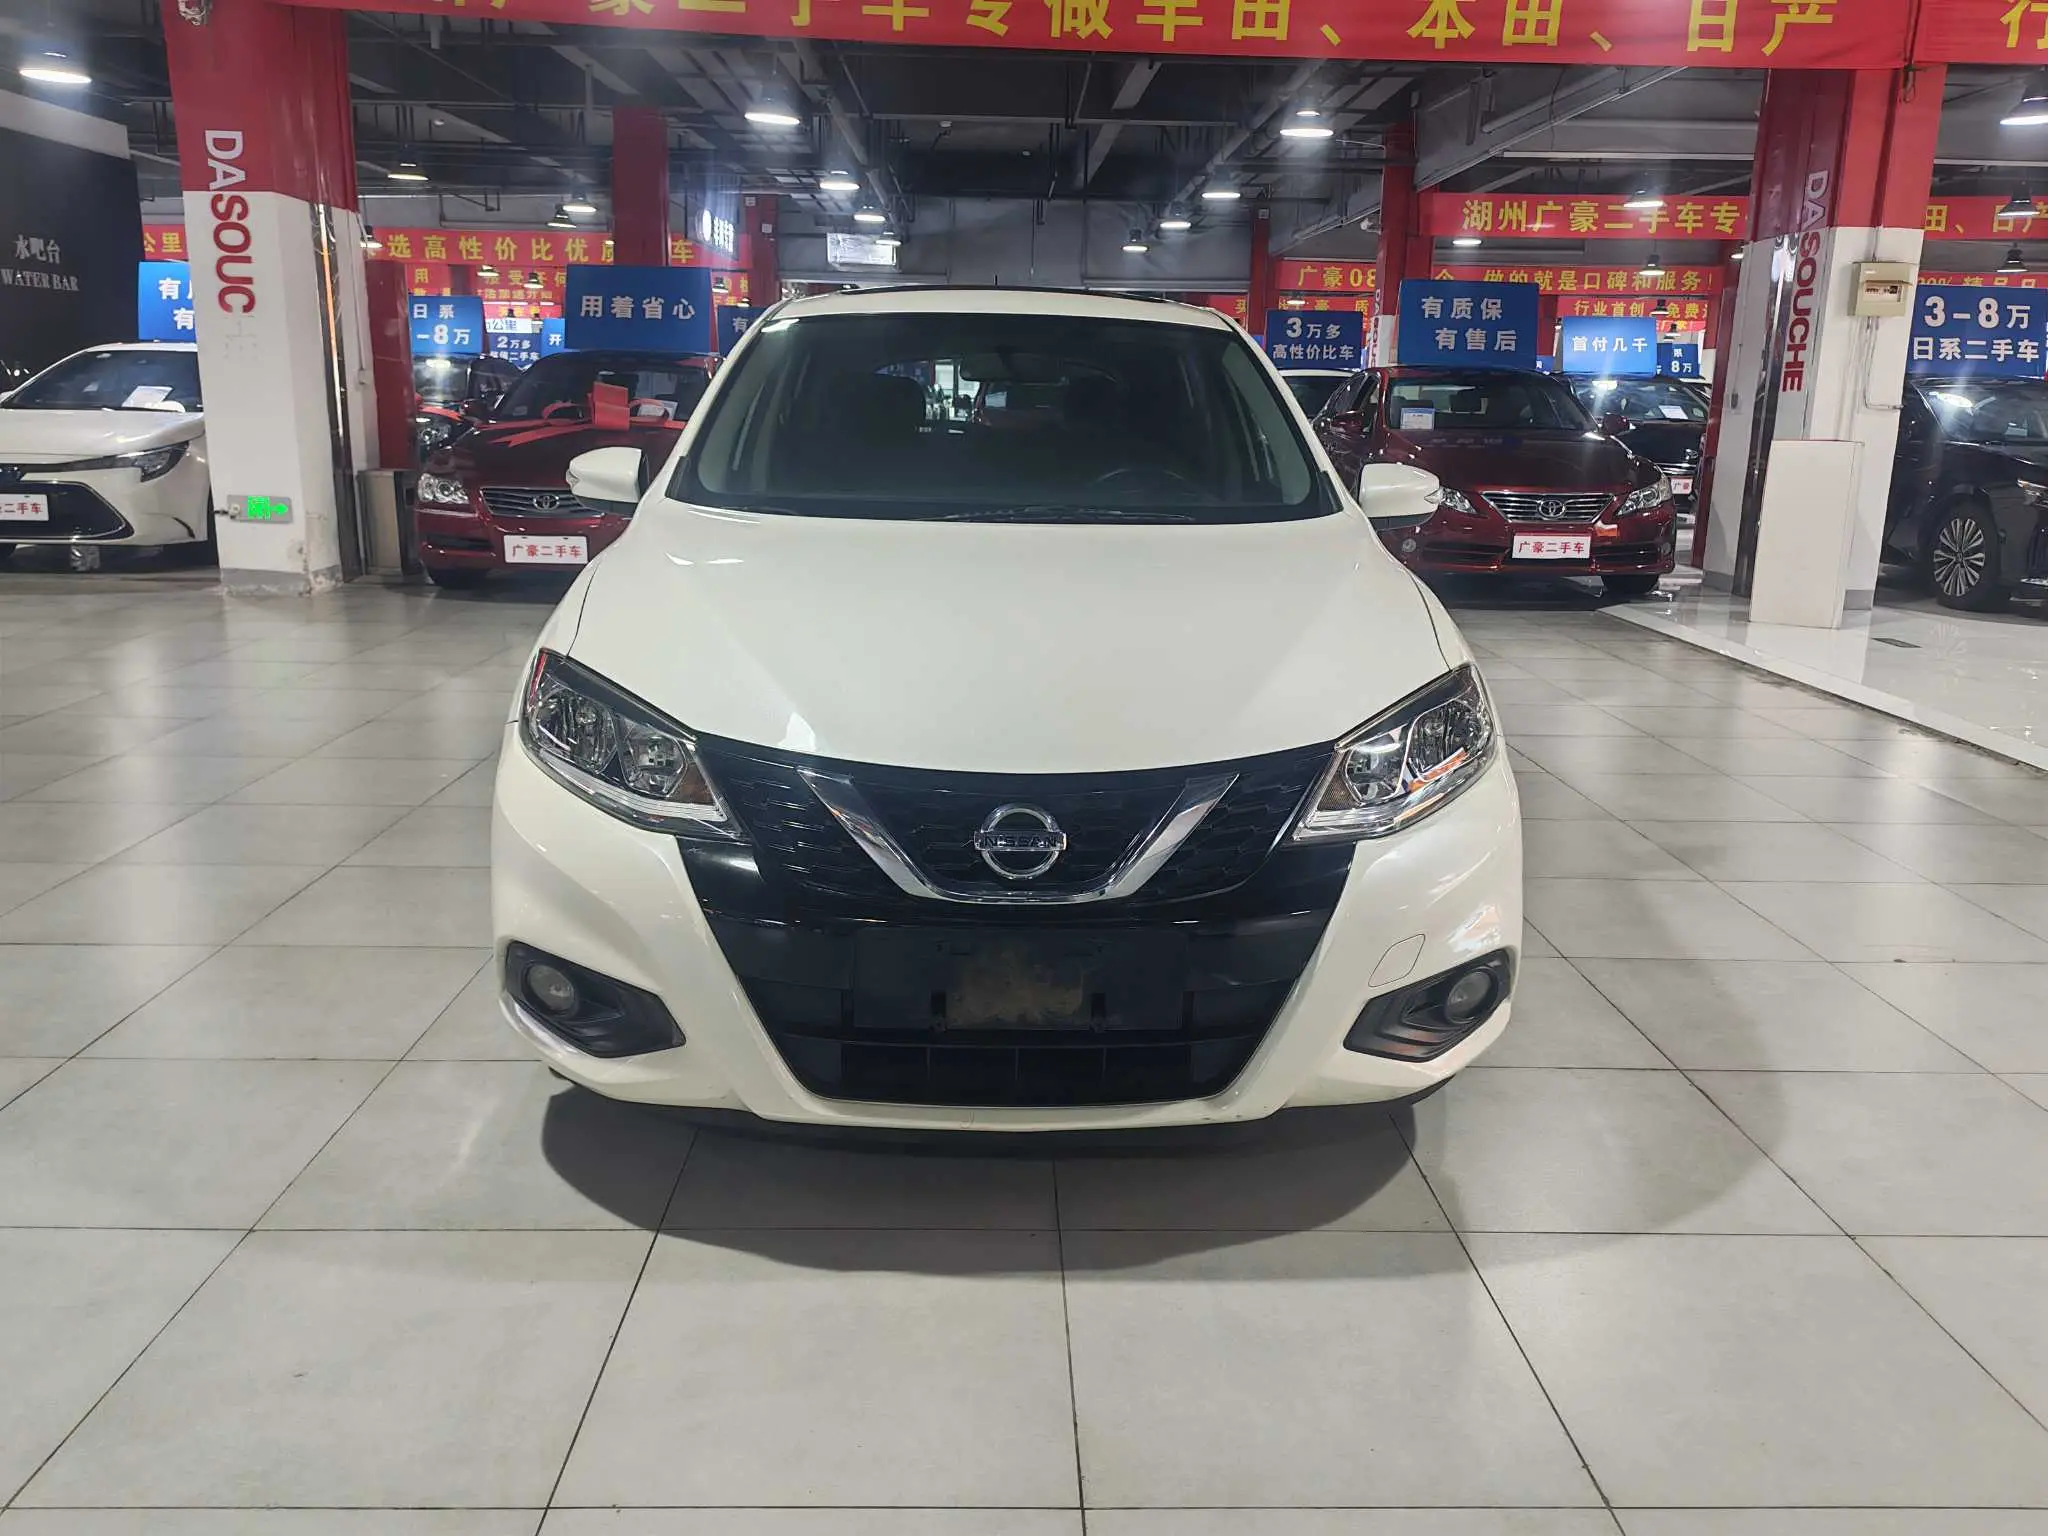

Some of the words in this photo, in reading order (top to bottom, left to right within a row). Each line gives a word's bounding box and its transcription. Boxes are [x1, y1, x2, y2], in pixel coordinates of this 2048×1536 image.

[1462, 199, 1741, 234] 湖州广豪二手车专
[14, 235, 60, 264] 水吧台
[143, 232, 182, 253] 公里
[1, 268, 51, 289] WATER
[53, 273, 80, 291] BAR
[158, 277, 193, 300] 有
[1782, 170, 1828, 392] DASOUCHE
[580, 294, 696, 321] 用着省心
[1421, 296, 1503, 321] 有质保
[1667, 302, 1708, 318] 免费
[1924, 295, 2030, 329] 3-8万
[1285, 317, 1341, 339] 3万多
[1435, 327, 1517, 352] 有售后
[1272, 343, 1354, 361] 高性价比车
[1572, 336, 1649, 353] 首付几千
[1913, 337, 2040, 362] 日系二手车
[1671, 360, 1693, 374] 8万
[0, 502, 44, 514] 二手车
[983, 836, 1058, 849] NISSAN
